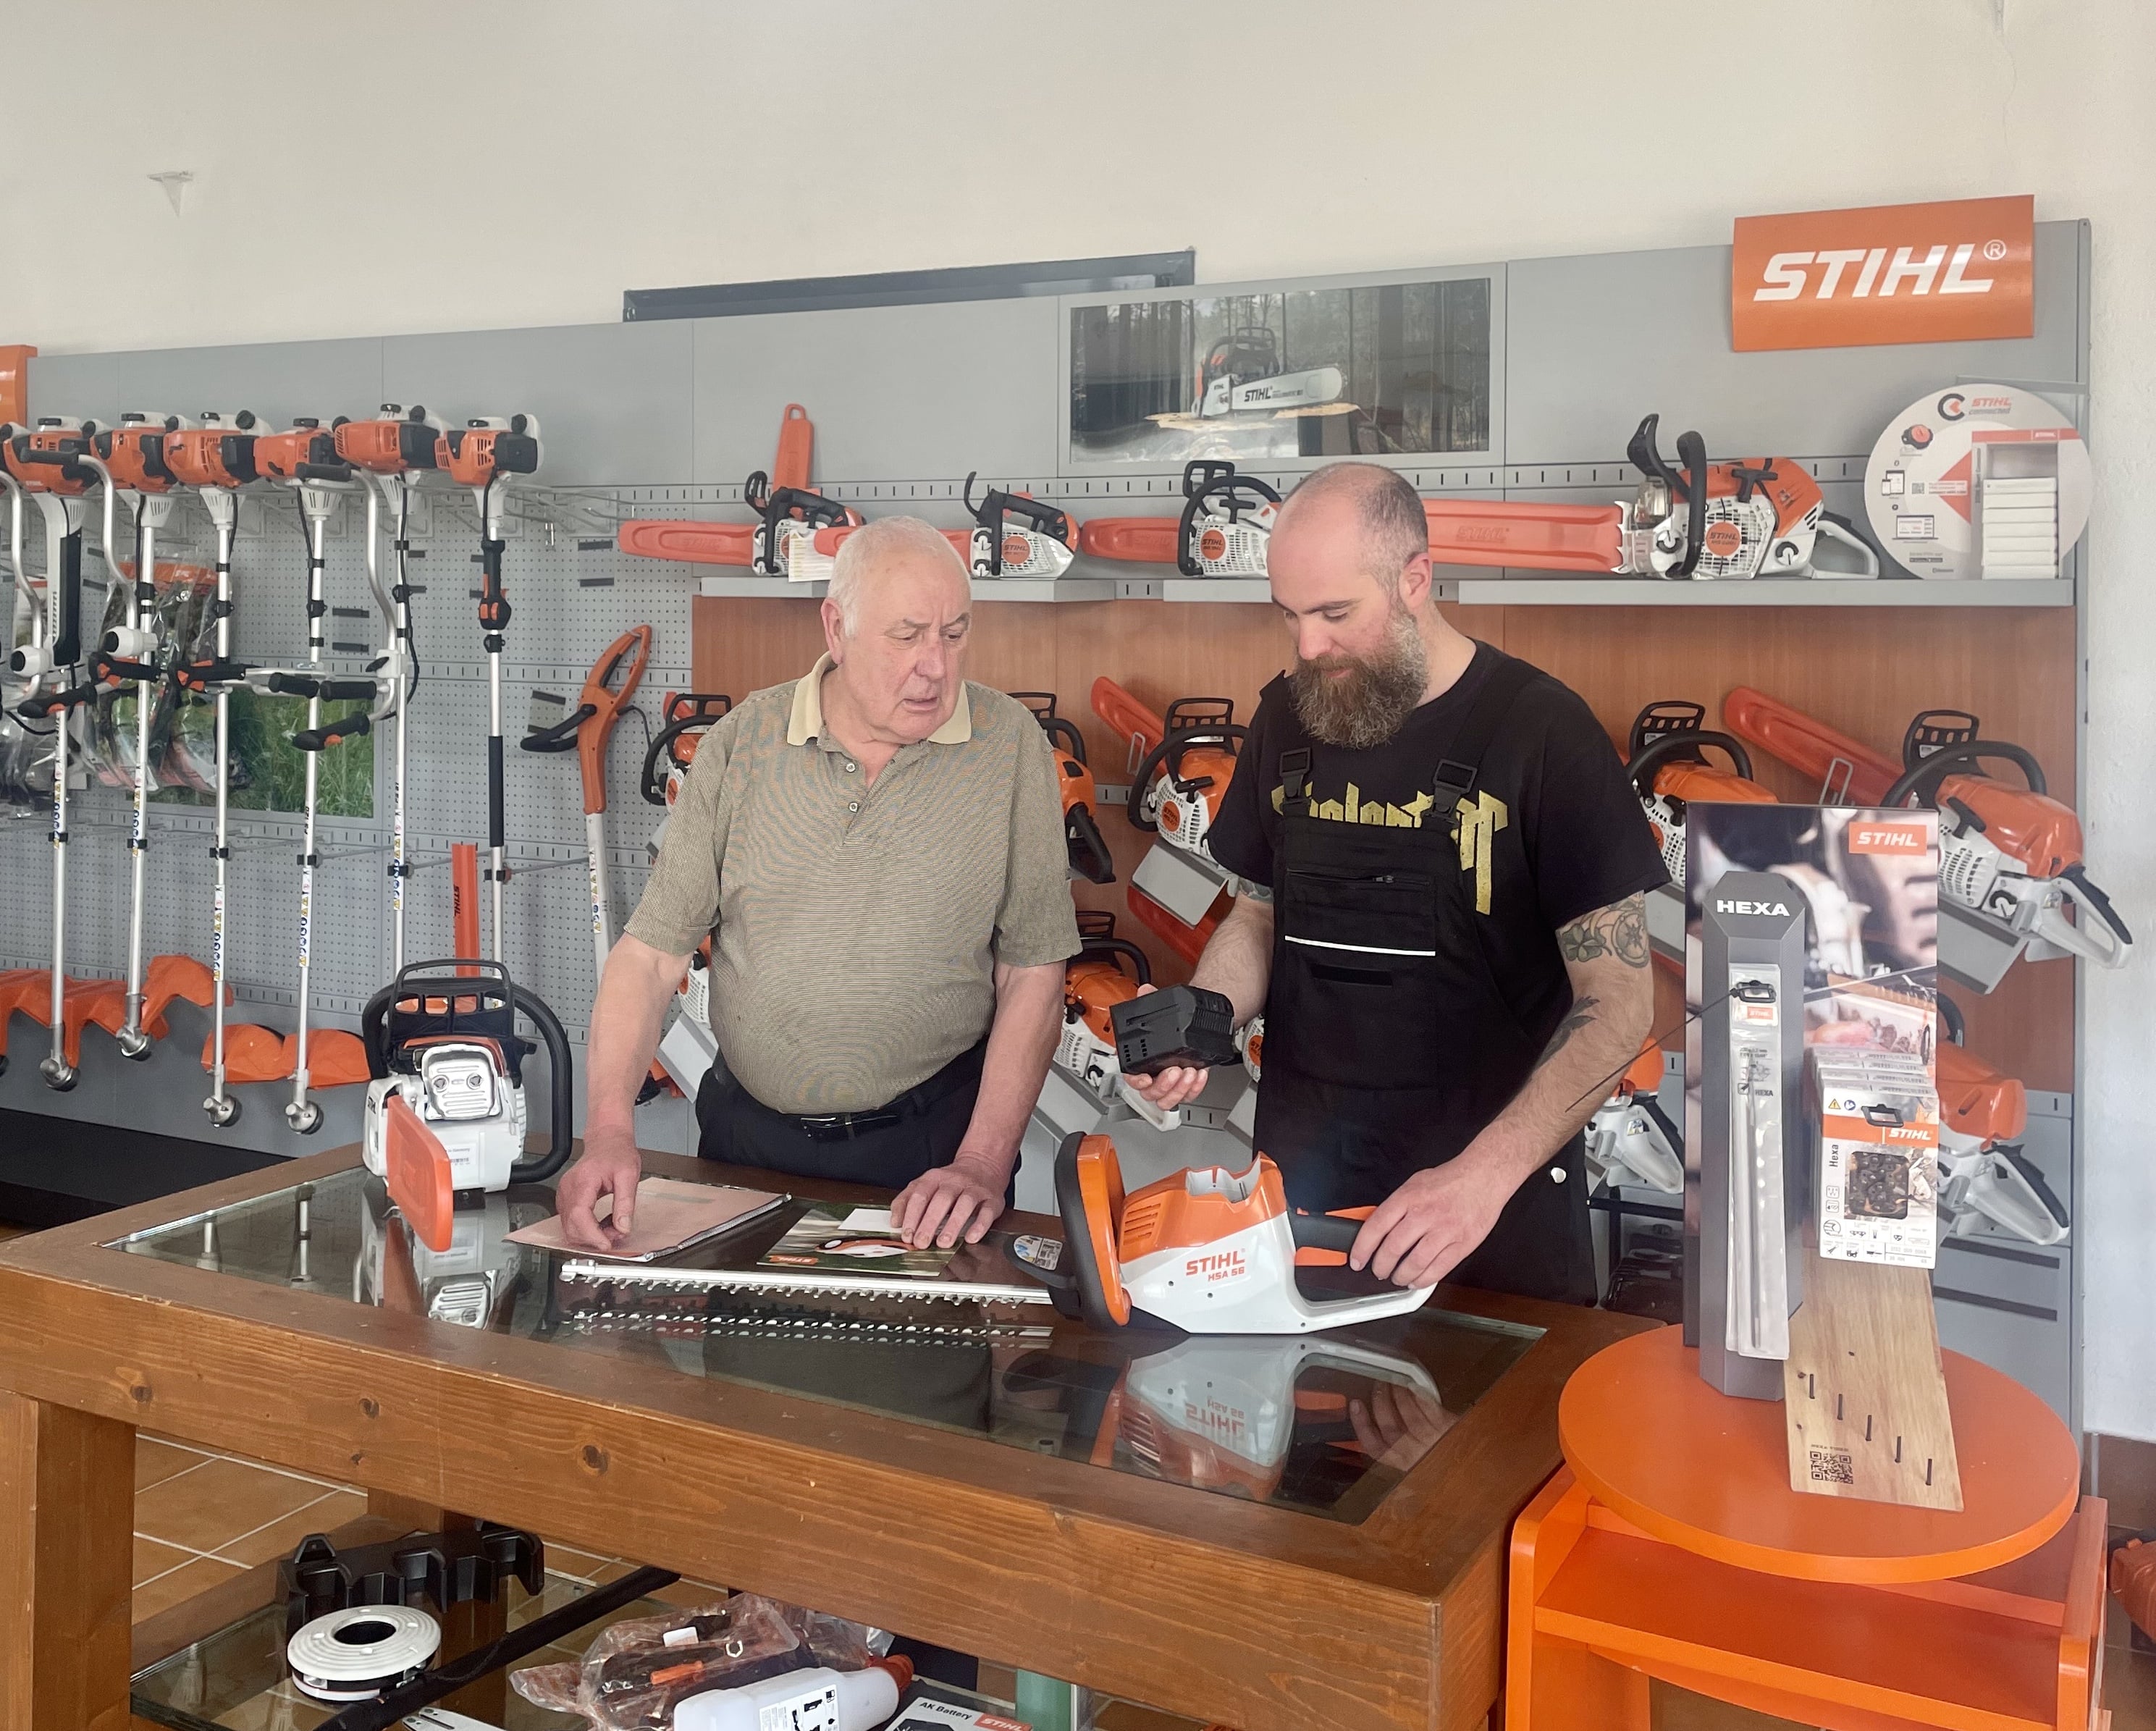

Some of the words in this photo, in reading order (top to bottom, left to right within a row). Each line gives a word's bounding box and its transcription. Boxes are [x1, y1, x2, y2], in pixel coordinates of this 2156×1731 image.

[1244, 386, 1273, 402] STIHL
[1971, 397, 2012, 407] STIHL
[1709, 531, 1738, 540] STIHL
[1856, 831, 1919, 847] STIHL
[1717, 899, 1790, 917] HEXA
[1888, 1129, 1932, 1140] STIHL
[1829, 1144, 1839, 1168] Hexa
[1186, 1250, 1245, 1276] STIHL
[1208, 1271, 1229, 1282] HSA
[919, 1701, 935, 1710] AK
[935, 1706, 973, 1721] Battery
